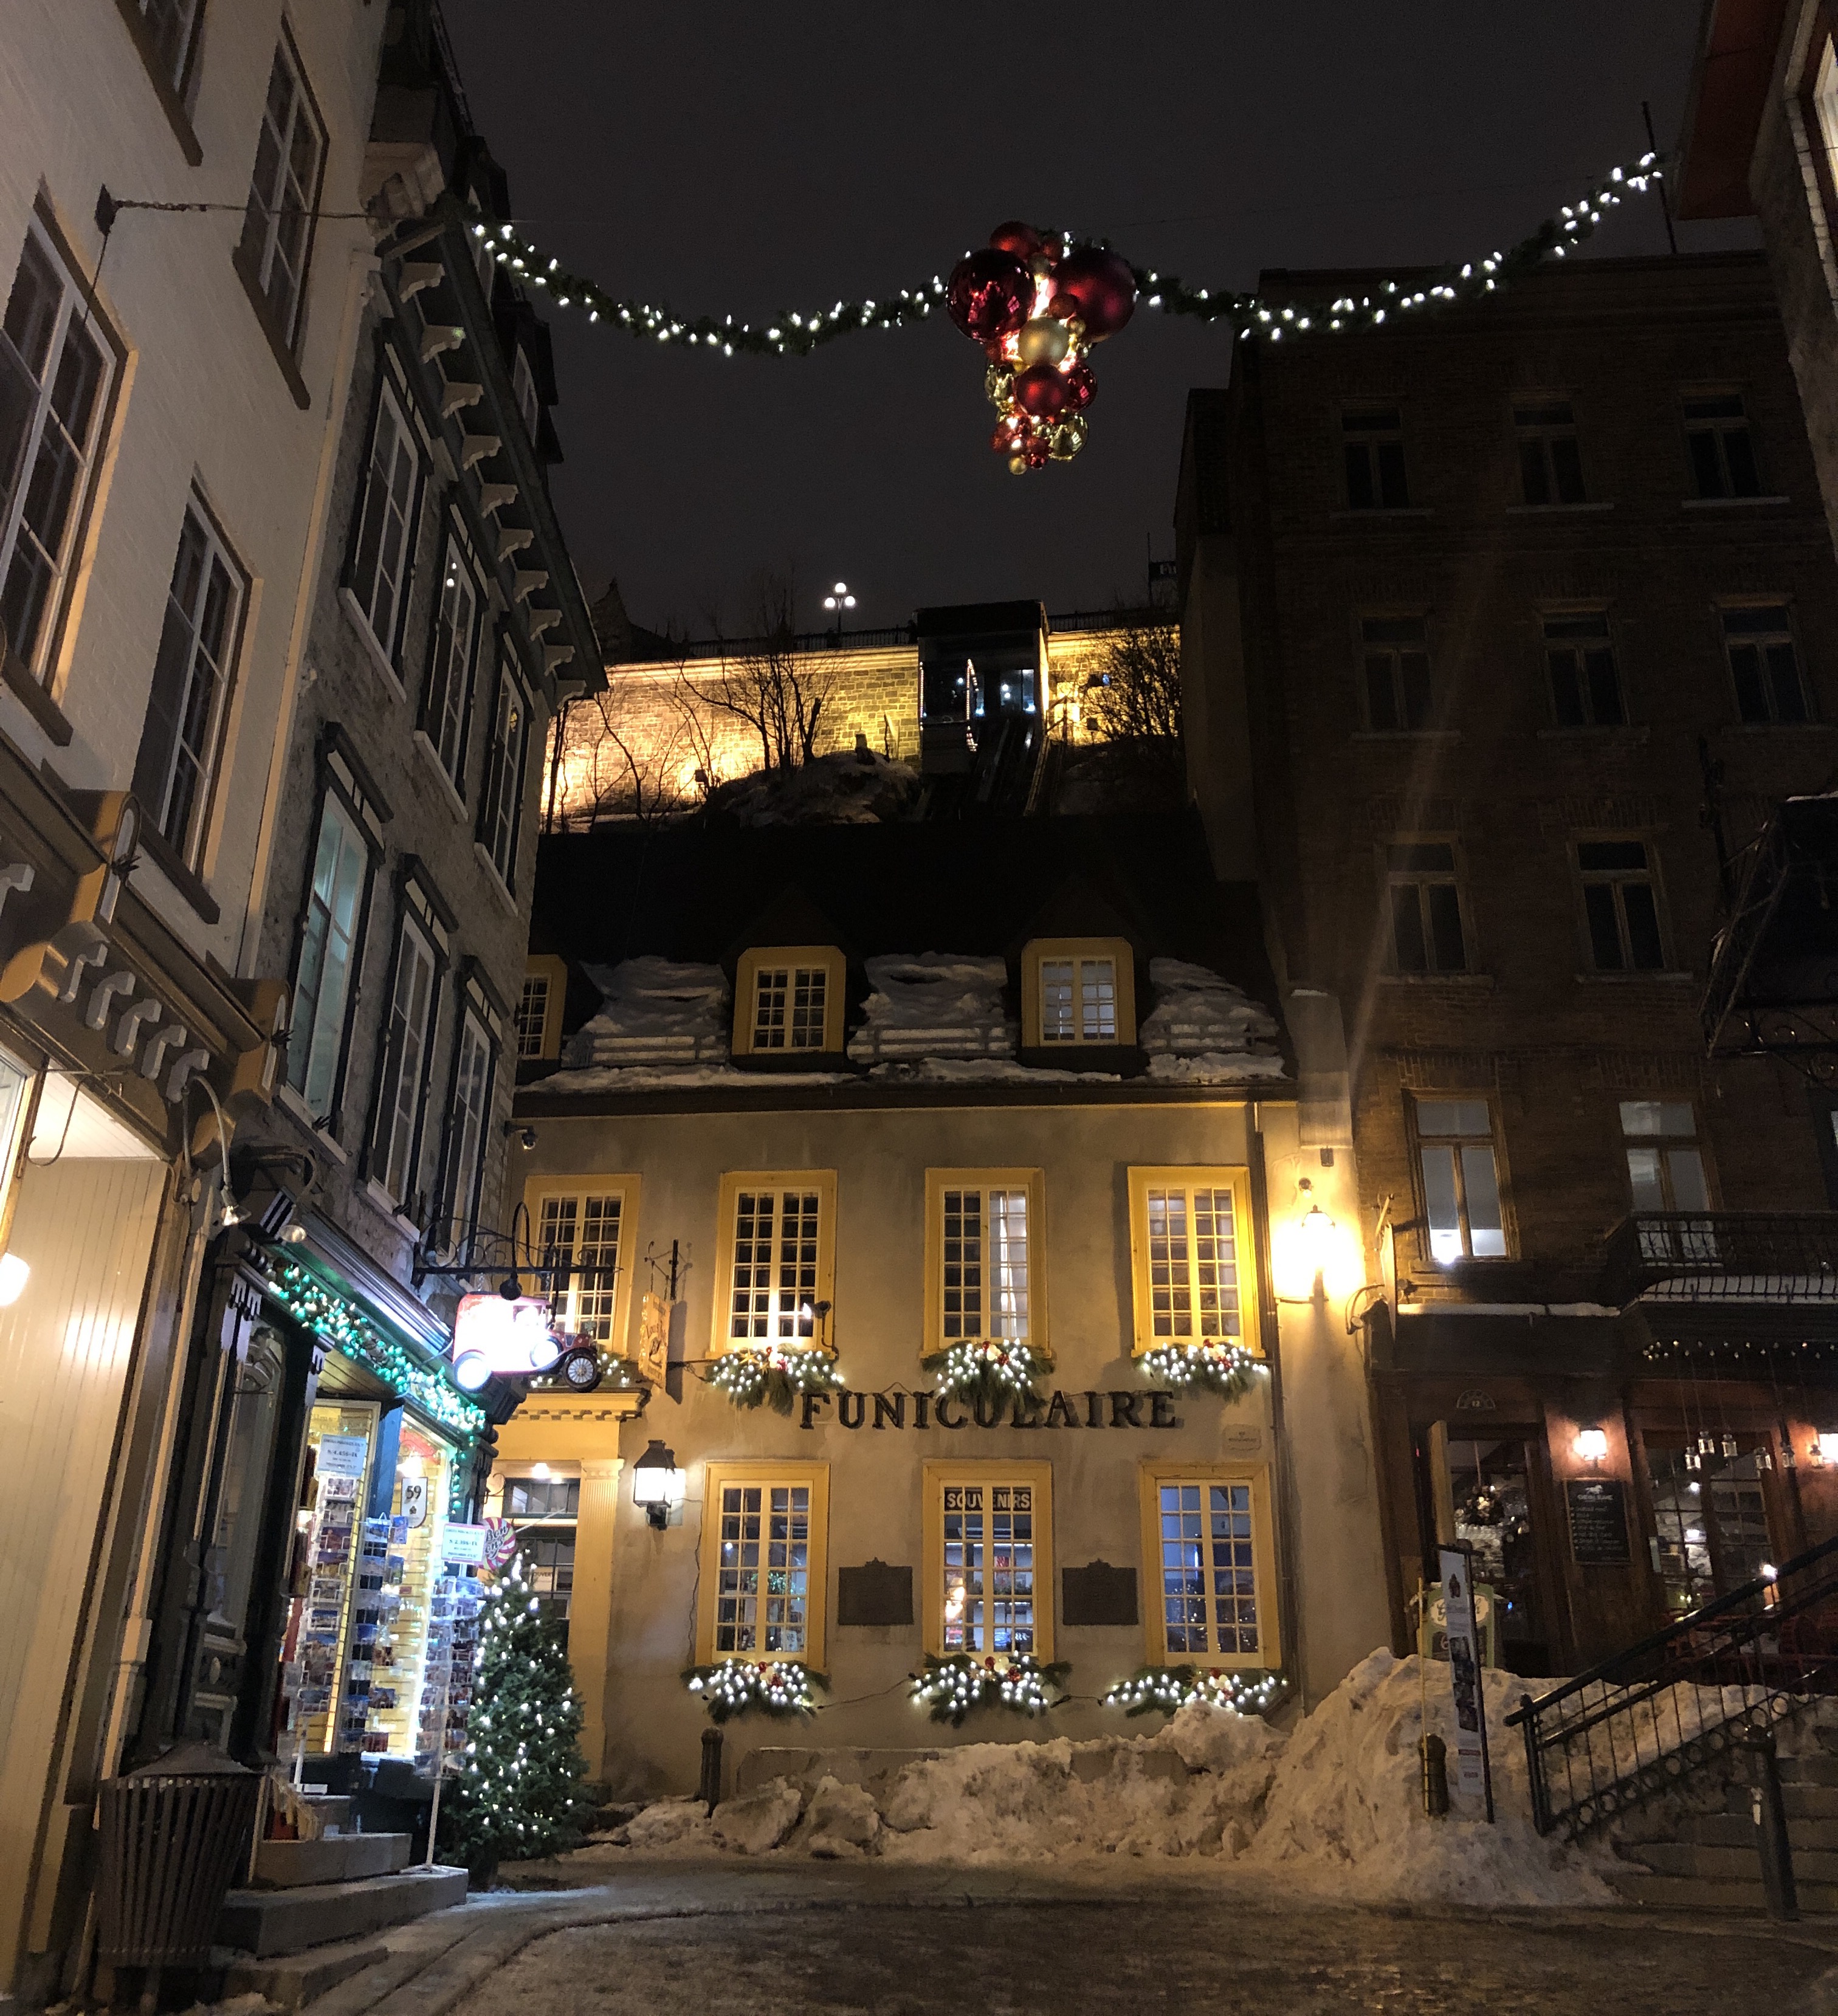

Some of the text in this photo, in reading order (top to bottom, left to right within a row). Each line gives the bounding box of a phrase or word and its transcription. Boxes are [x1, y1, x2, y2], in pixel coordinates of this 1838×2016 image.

[799, 1390, 1178, 1429] FUNICULAIRE
[406, 1485, 422, 1500] 59
[486, 1526, 508, 1543] Bon
